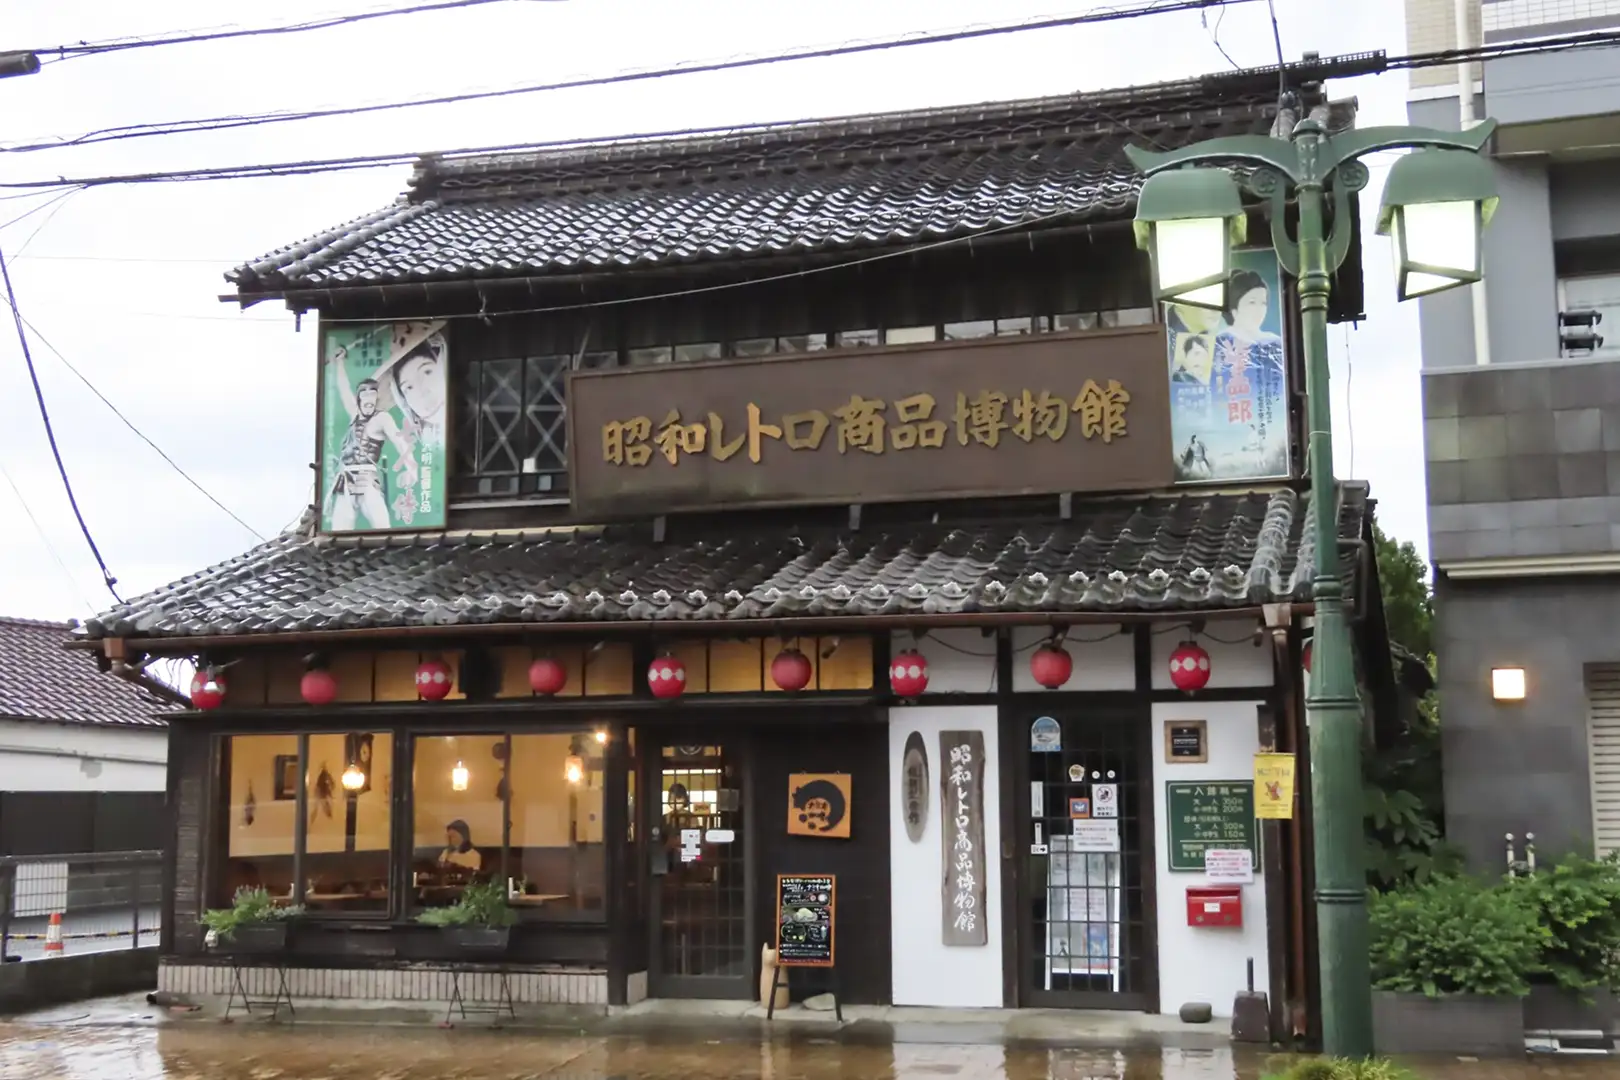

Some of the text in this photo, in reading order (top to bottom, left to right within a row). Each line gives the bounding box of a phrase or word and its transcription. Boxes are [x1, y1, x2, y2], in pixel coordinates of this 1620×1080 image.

[602, 378, 1131, 467] 昭和レトロ商品博物館
[949, 744, 977, 932] 昭和レトロ商品博物館
